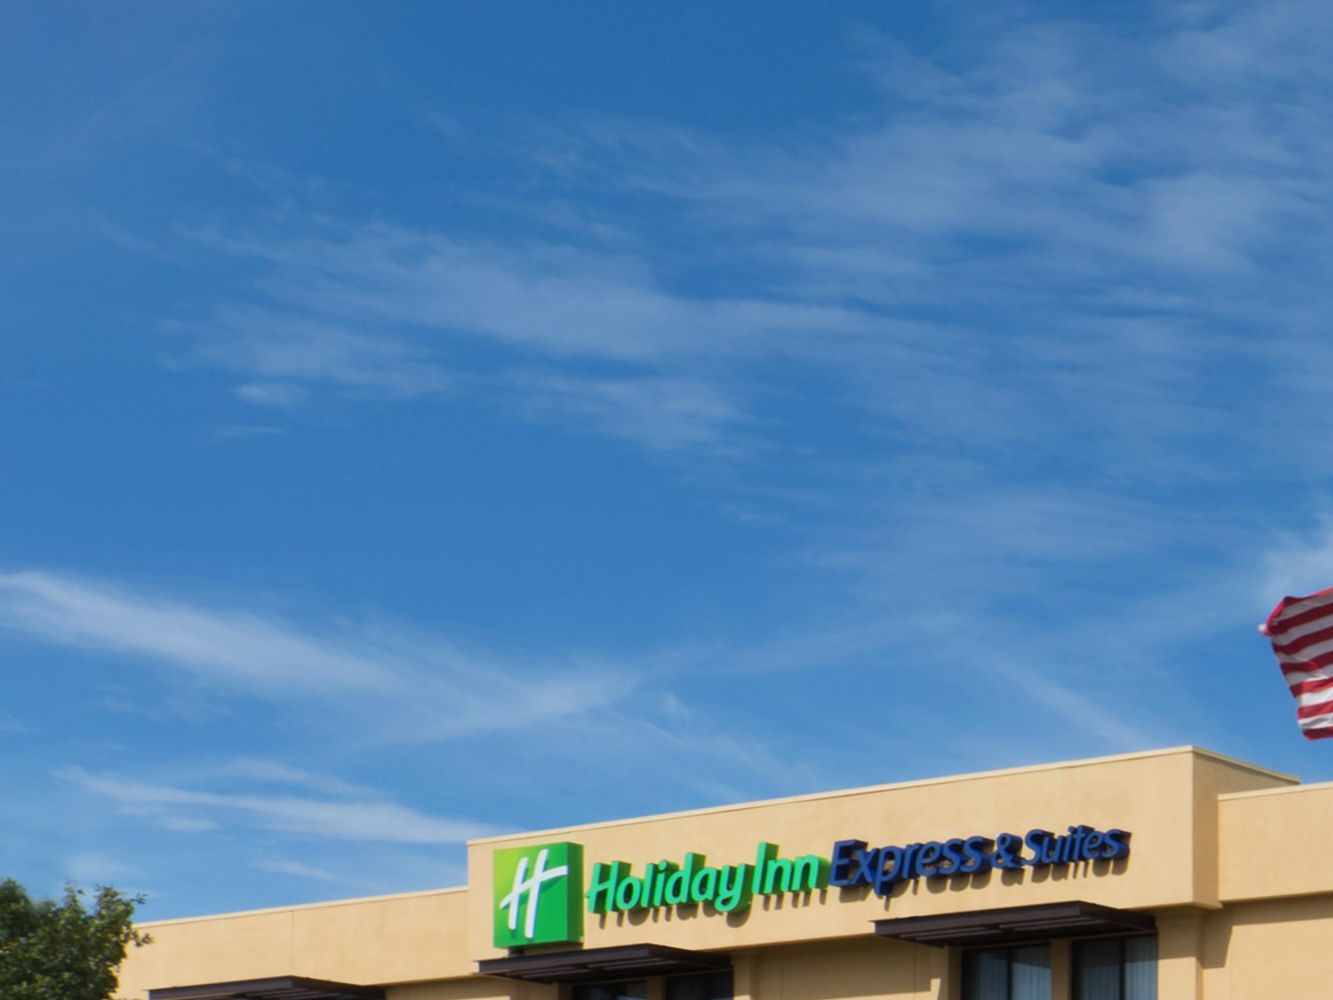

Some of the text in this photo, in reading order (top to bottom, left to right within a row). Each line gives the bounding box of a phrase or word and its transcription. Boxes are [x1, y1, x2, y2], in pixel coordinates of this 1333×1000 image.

[586, 825, 1131, 914] Holiday Inn Express & Suites
